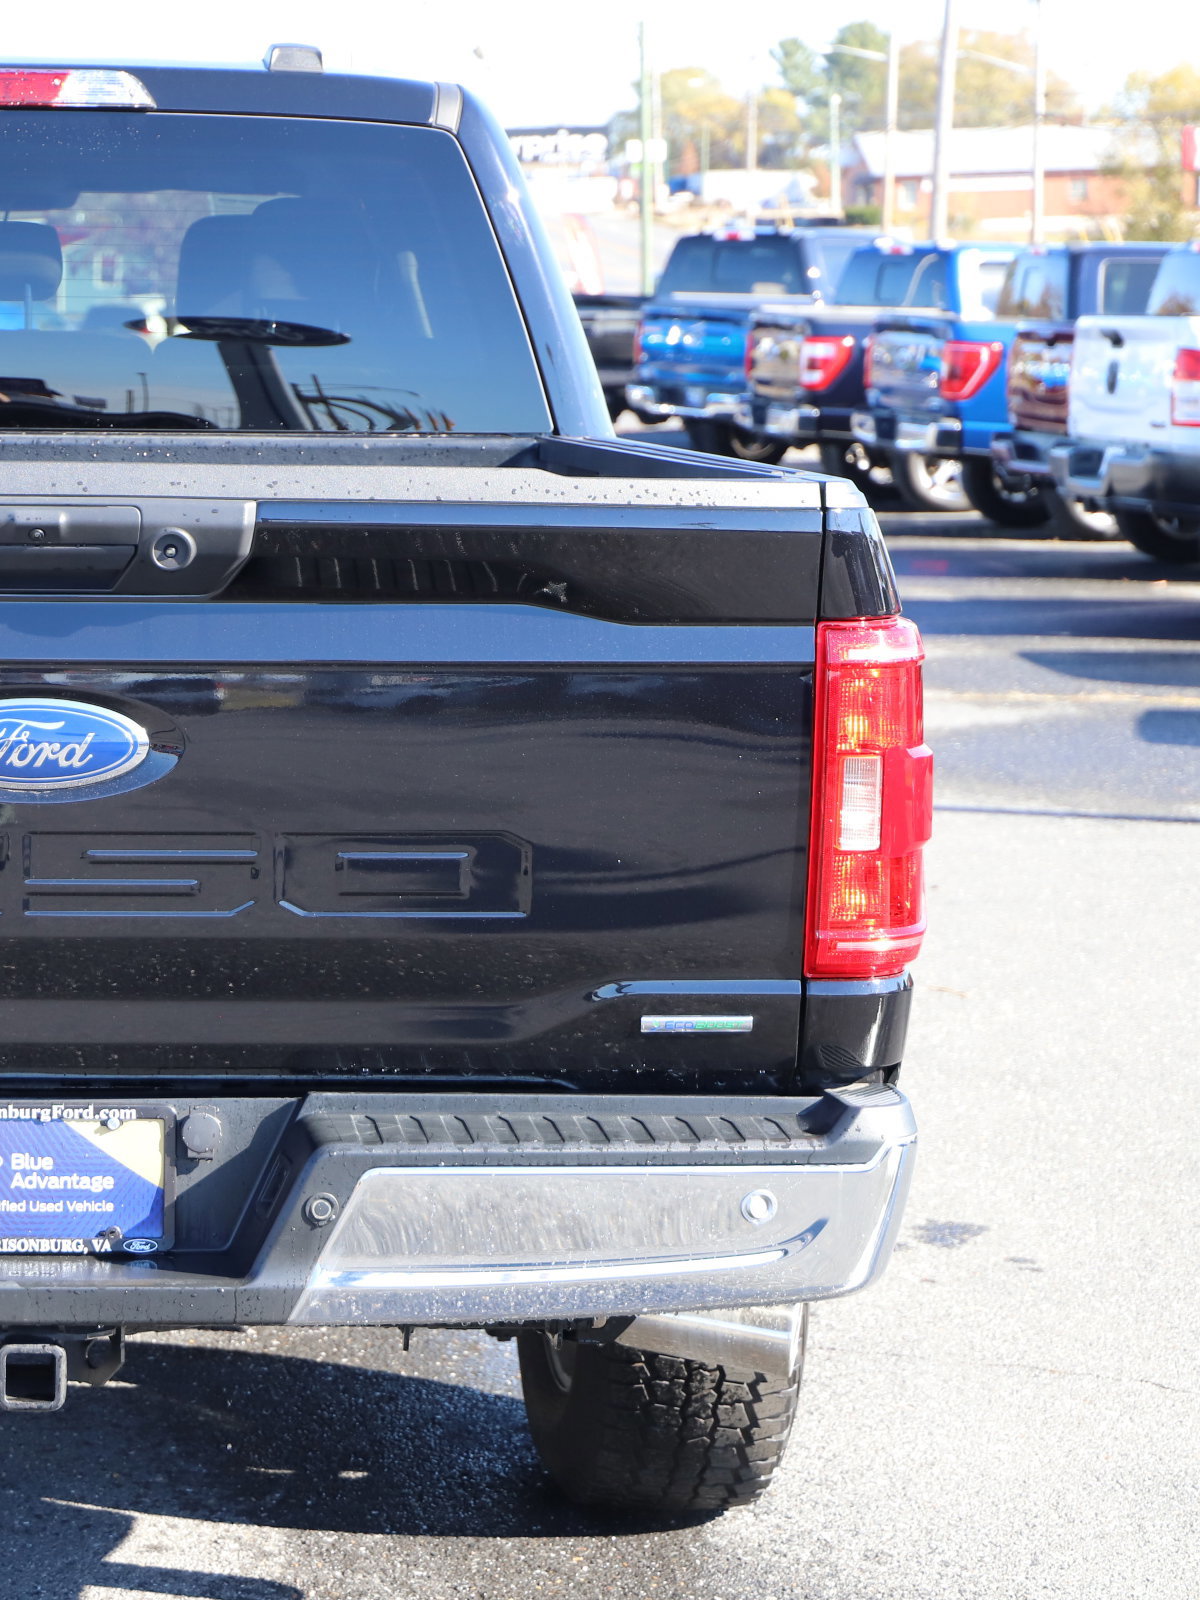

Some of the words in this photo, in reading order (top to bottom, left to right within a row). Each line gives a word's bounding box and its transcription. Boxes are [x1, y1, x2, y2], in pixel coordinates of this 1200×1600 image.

[11, 1153, 54, 1170] Blue
[10, 1172, 114, 1192] Advantage
[29, 1200, 64, 1212] Used
[66, 1200, 114, 1212] Vehicle
[92, 1238, 112, 1253] VA
